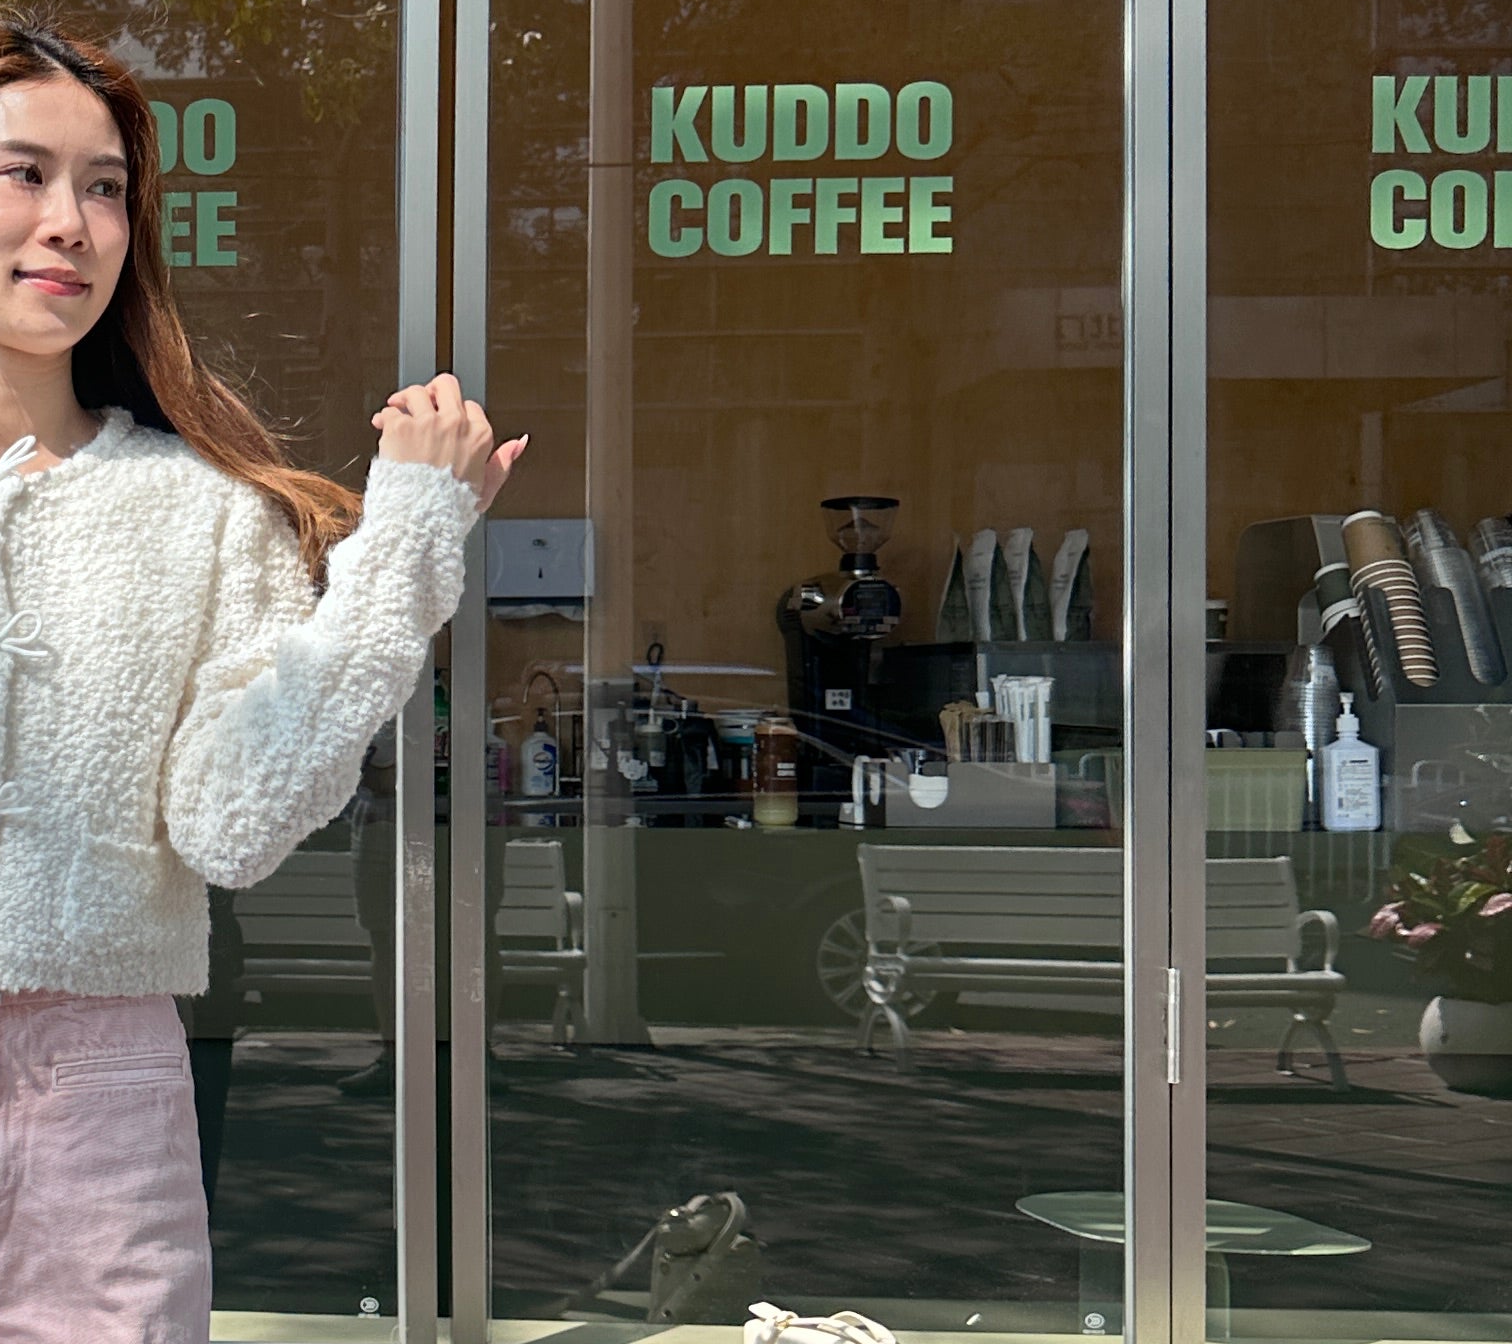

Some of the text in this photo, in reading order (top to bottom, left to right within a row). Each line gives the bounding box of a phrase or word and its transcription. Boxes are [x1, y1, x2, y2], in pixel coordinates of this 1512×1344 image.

[651, 82, 953, 162] KUDDO
[1372, 75, 1512, 154] KU
[649, 177, 953, 257] COFFEE
